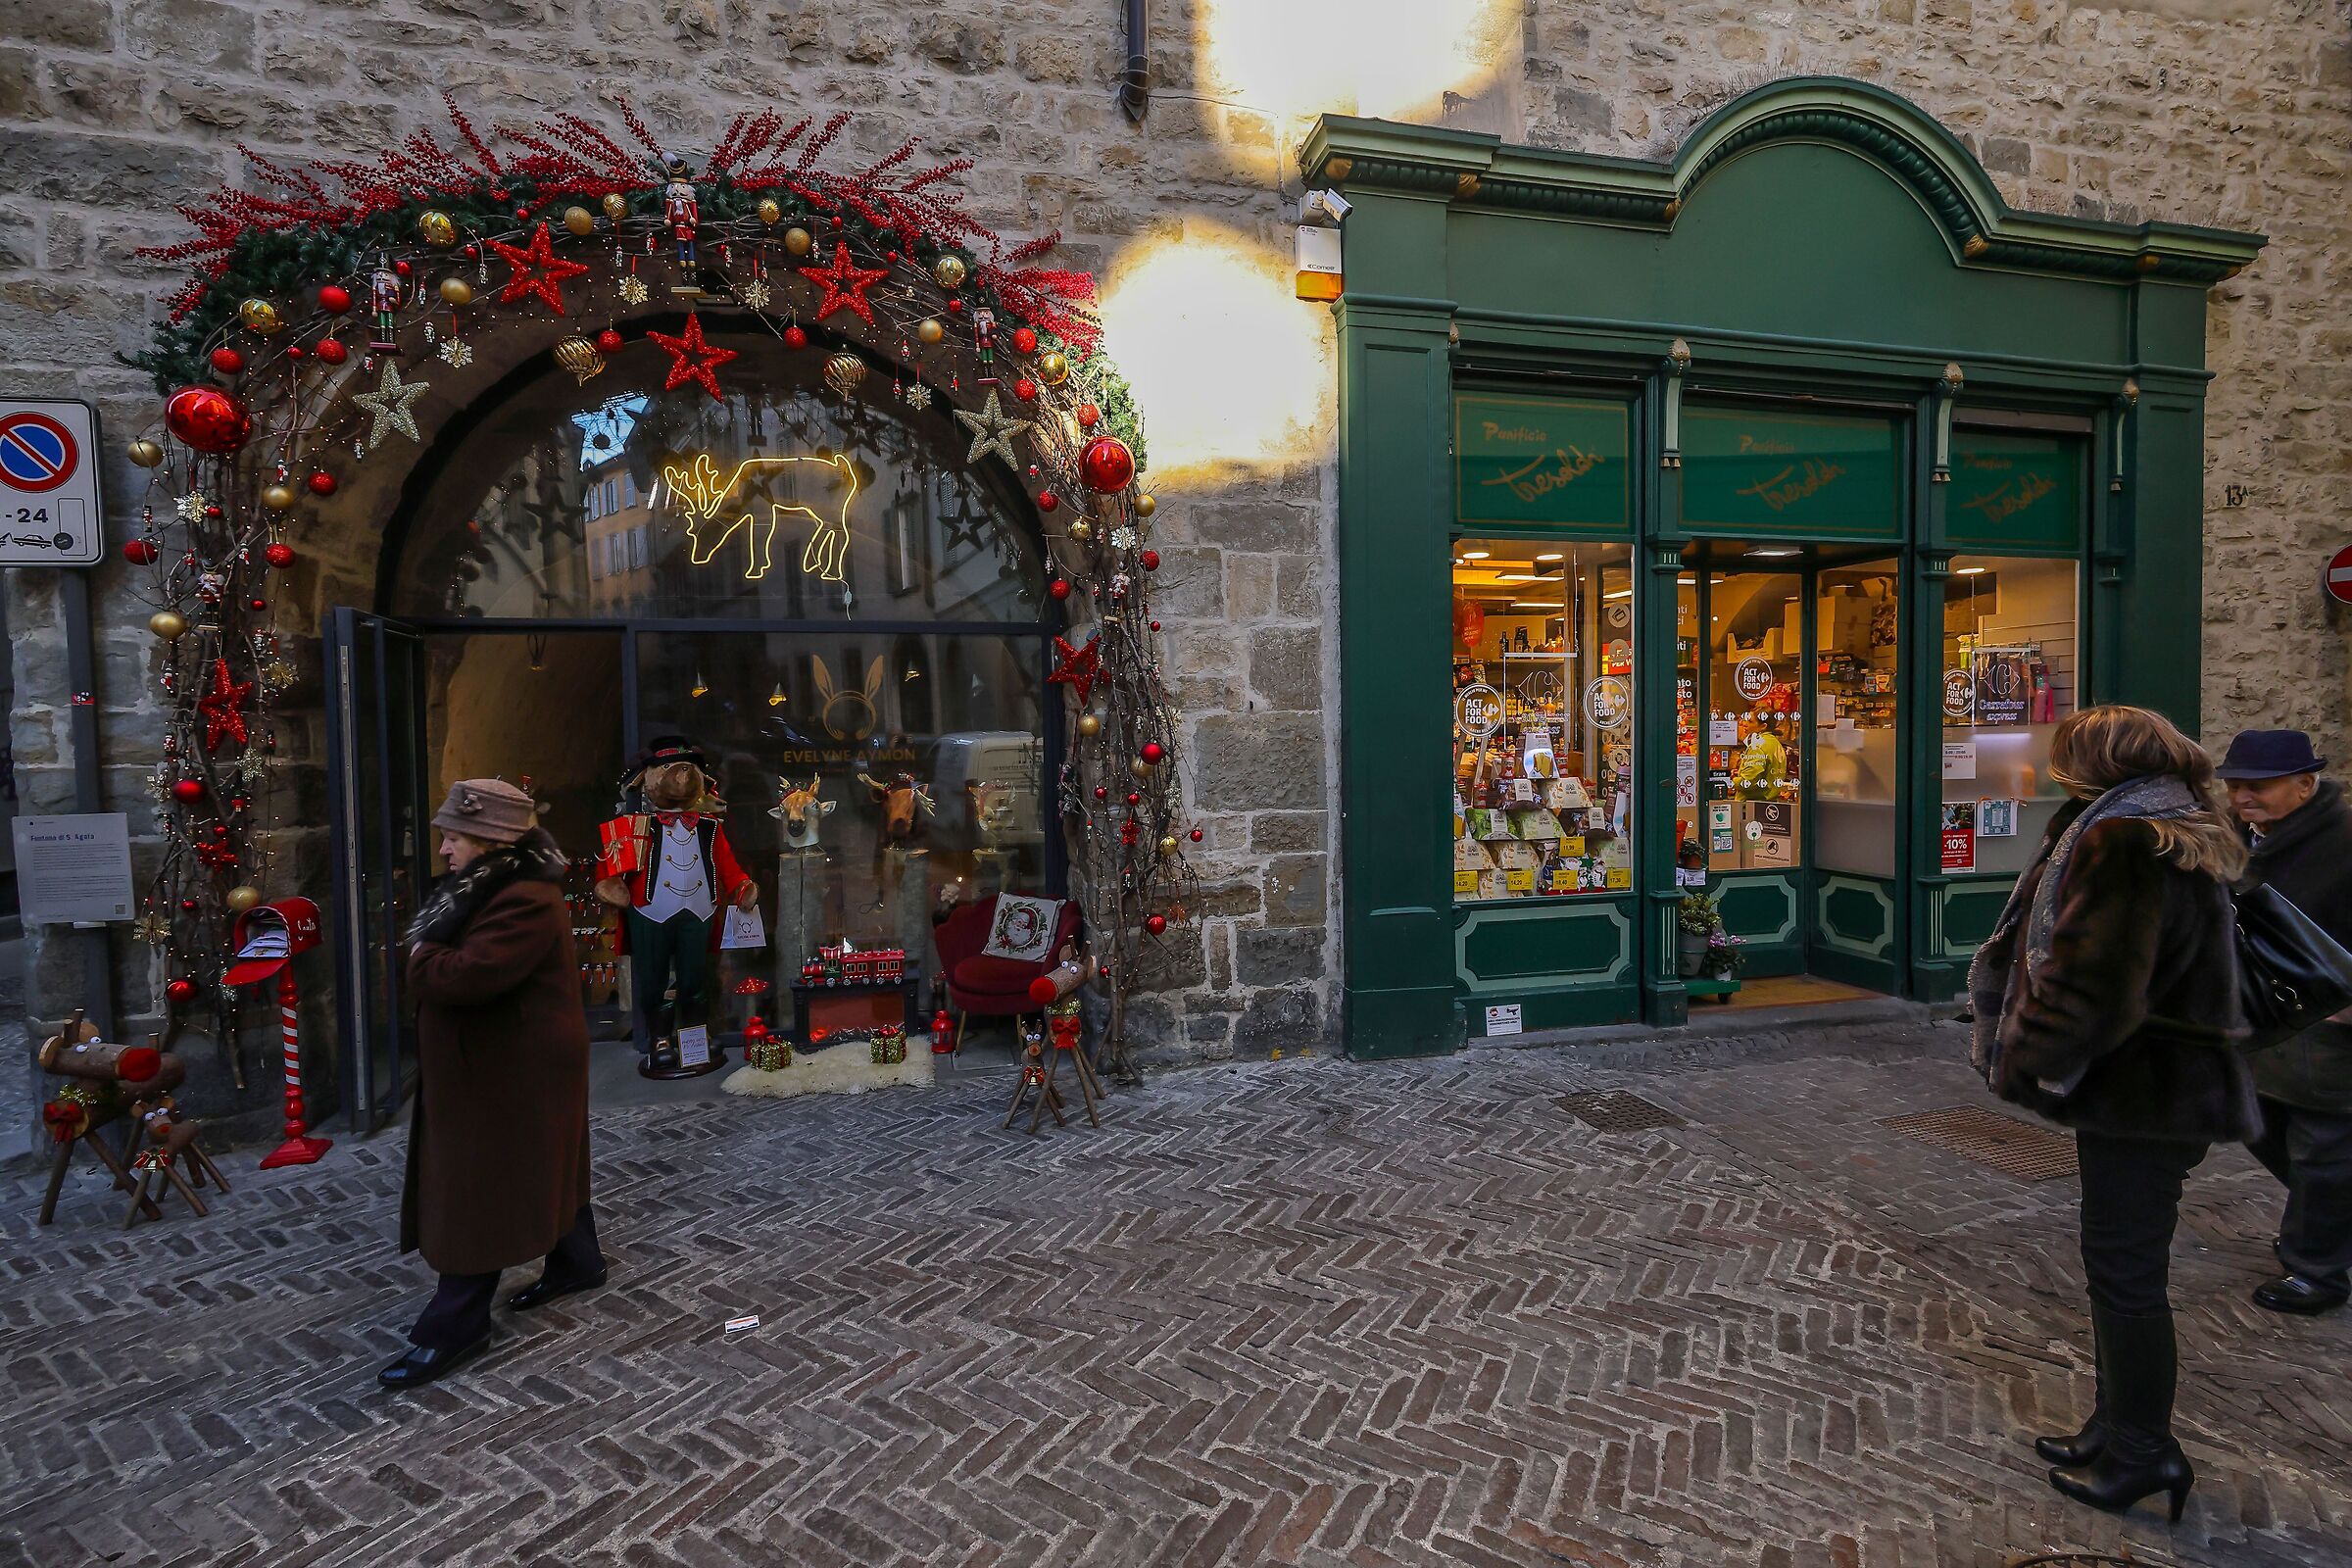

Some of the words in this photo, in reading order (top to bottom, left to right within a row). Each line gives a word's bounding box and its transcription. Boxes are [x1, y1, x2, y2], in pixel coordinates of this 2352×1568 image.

[1482, 421, 1547, 441] Panificio
[17, 508, 49, 523] 24
[1744, 667, 1758, 676] ACT
[1946, 682, 1961, 691] ACT
[1465, 699, 1484, 708] ACT
[1593, 701, 1609, 710] FOR
[1945, 697, 1964, 706] FOOD
[1979, 699, 2026, 710] Carrefour
[1465, 708, 1482, 716] FOR
[1593, 708, 1616, 717] FOOD
[1465, 715, 1488, 724] FOOD
[784, 749, 853, 763] EVELYNE
[856, 748, 916, 762] AYMON
[1944, 838, 1968, 850] -10%
